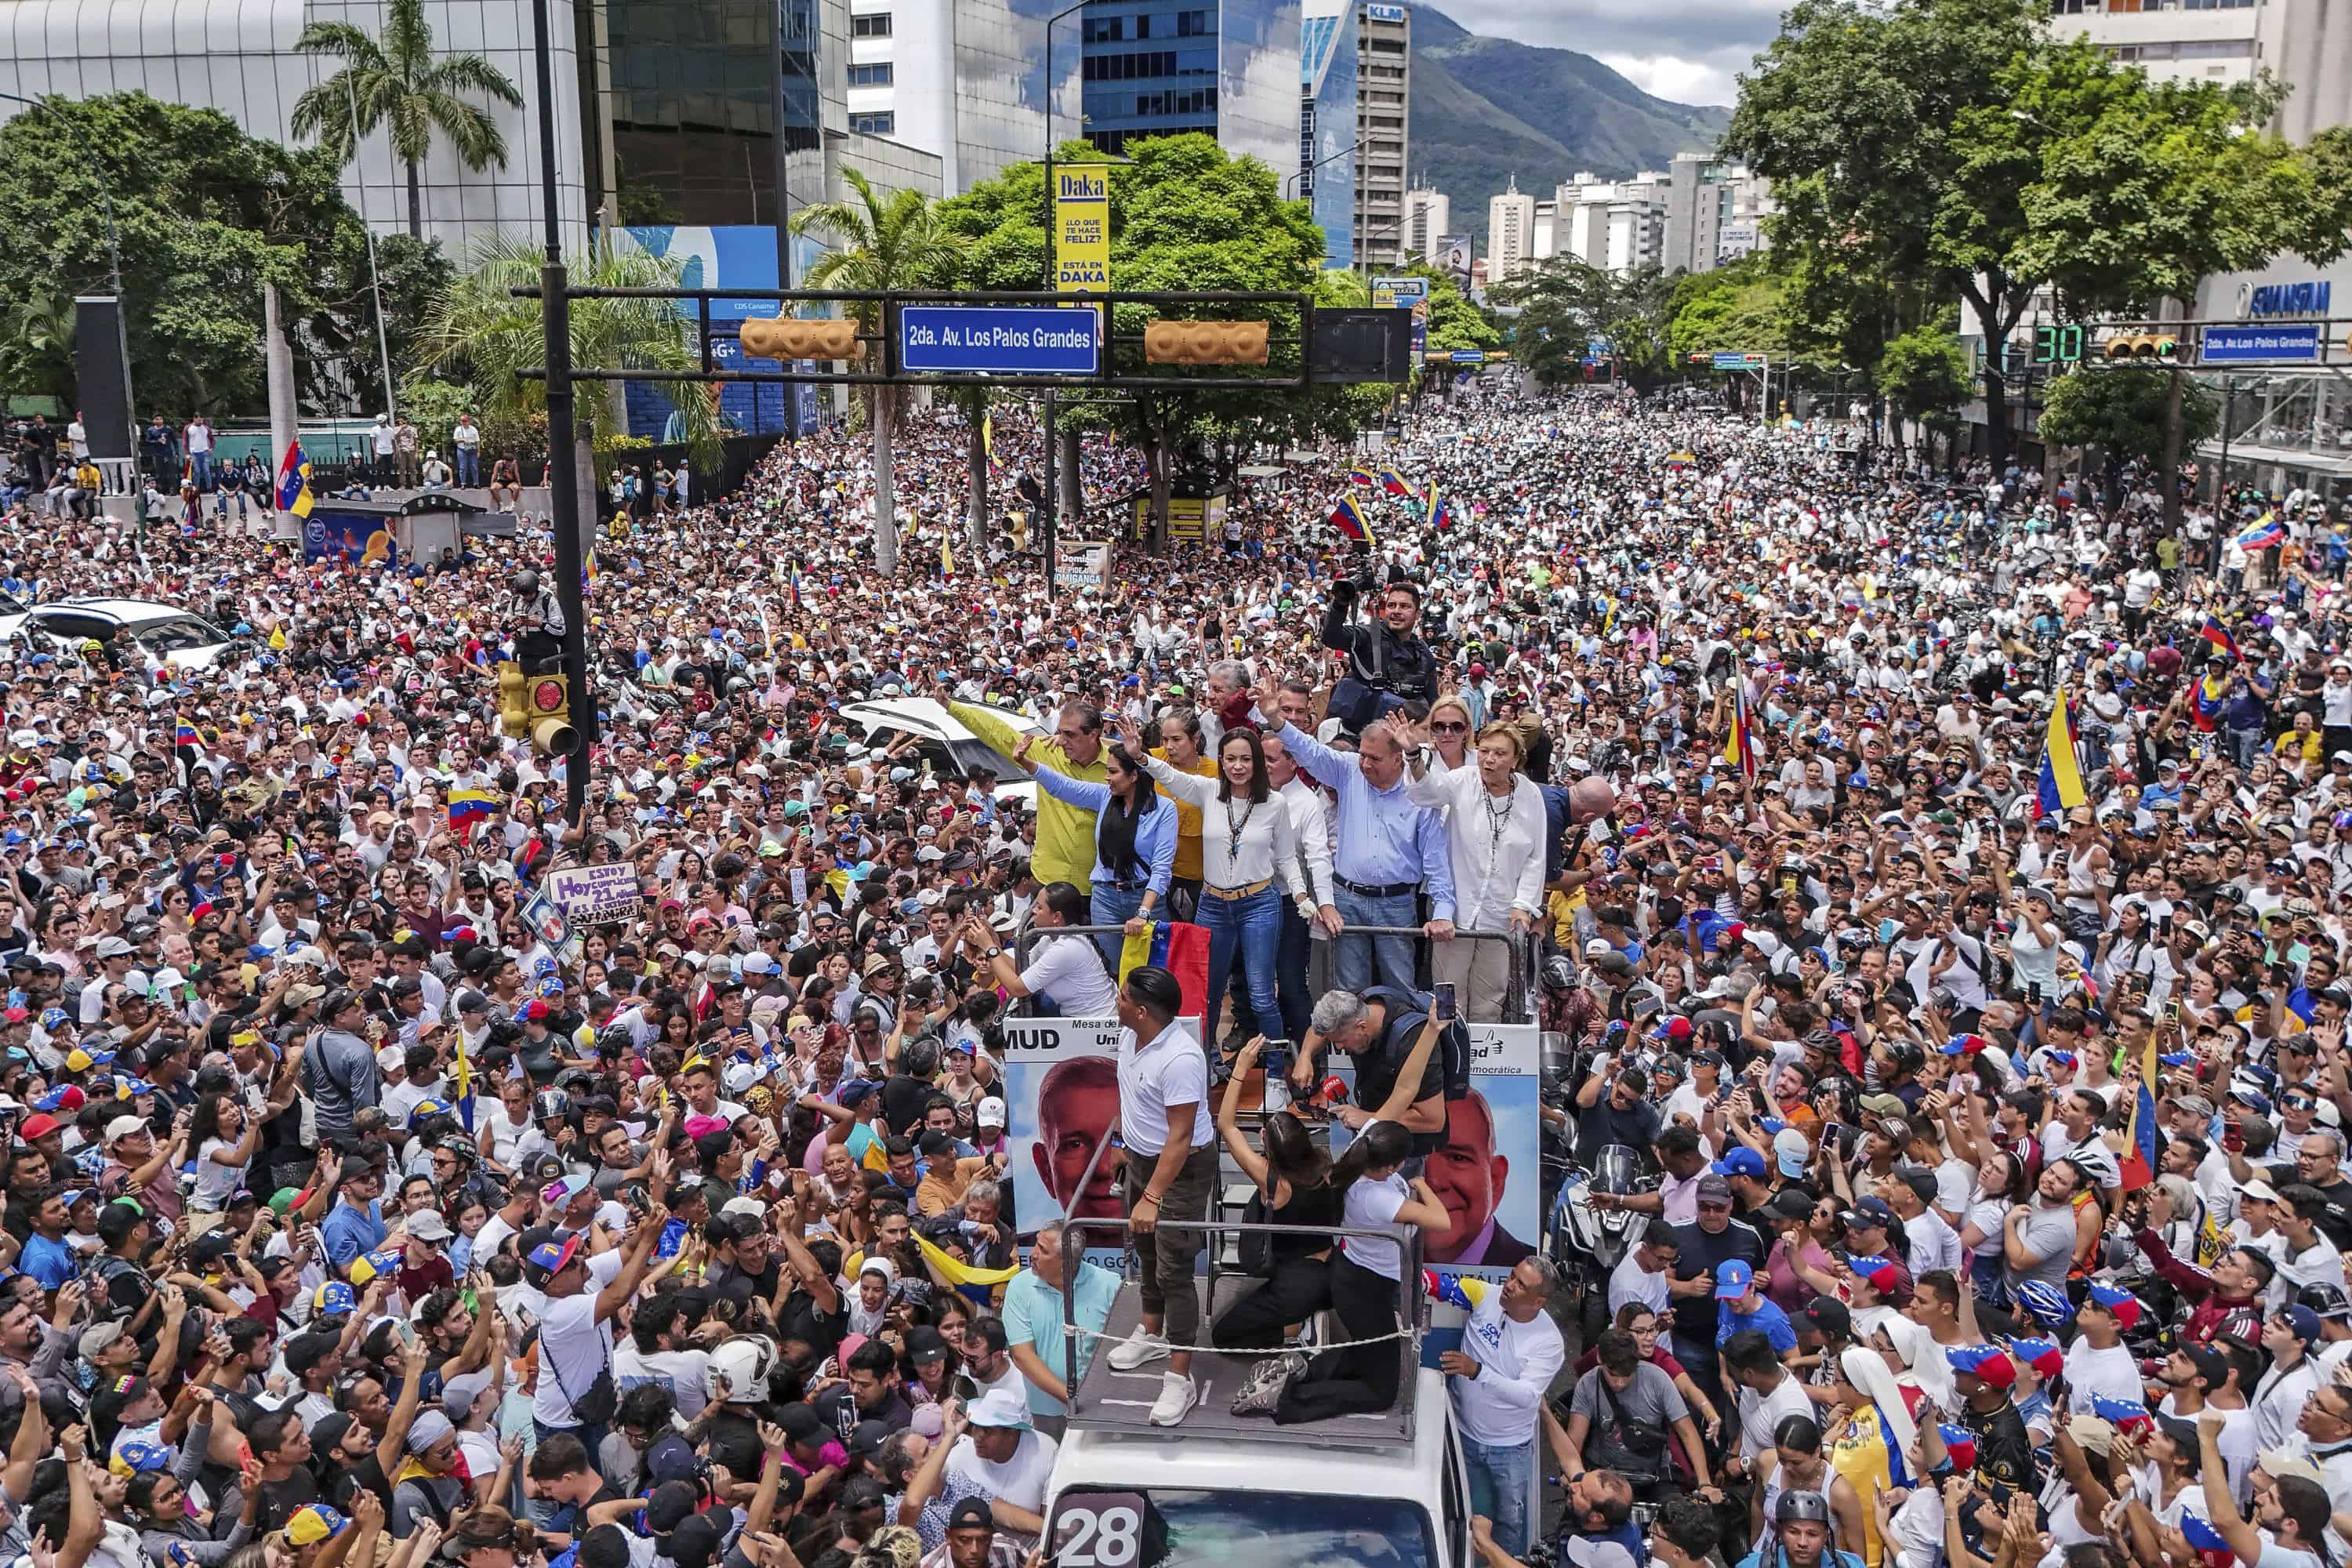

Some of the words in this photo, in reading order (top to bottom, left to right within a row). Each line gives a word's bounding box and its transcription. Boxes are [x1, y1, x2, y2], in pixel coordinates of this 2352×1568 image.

[1369, 5, 1402, 20] KLM
[1060, 174, 1104, 197] Daka
[1065, 235, 1102, 244] FELIZ?
[1063, 260, 1087, 269] ESTÁ
[1060, 271, 1106, 283] DAKA
[909, 325, 938, 346] 2da.
[942, 326, 961, 347] Av.
[965, 327, 990, 347] Los
[993, 327, 1029, 348] Palos
[1033, 327, 1091, 349] Grandes
[2036, 325, 2082, 362] 30
[2206, 338, 2223, 350] 2da.
[2238, 337, 2252, 349] Los
[2255, 337, 2278, 348] Palos
[2279, 336, 2314, 347] Grandes
[589, 866, 626, 880] ESTOY
[593, 888, 615, 903] 21
[573, 904, 589, 913] ES
[1072, 1020, 1101, 1029] Mesa
[1105, 1020, 1116, 1029] de
[1004, 1029, 1060, 1050] MUD
[1096, 1034, 1120, 1045] Uni
[1469, 1065, 1522, 1074] emocrática
[1441, 1272, 1508, 1287] ONÁLE
[1056, 1506, 1138, 1566] 28
